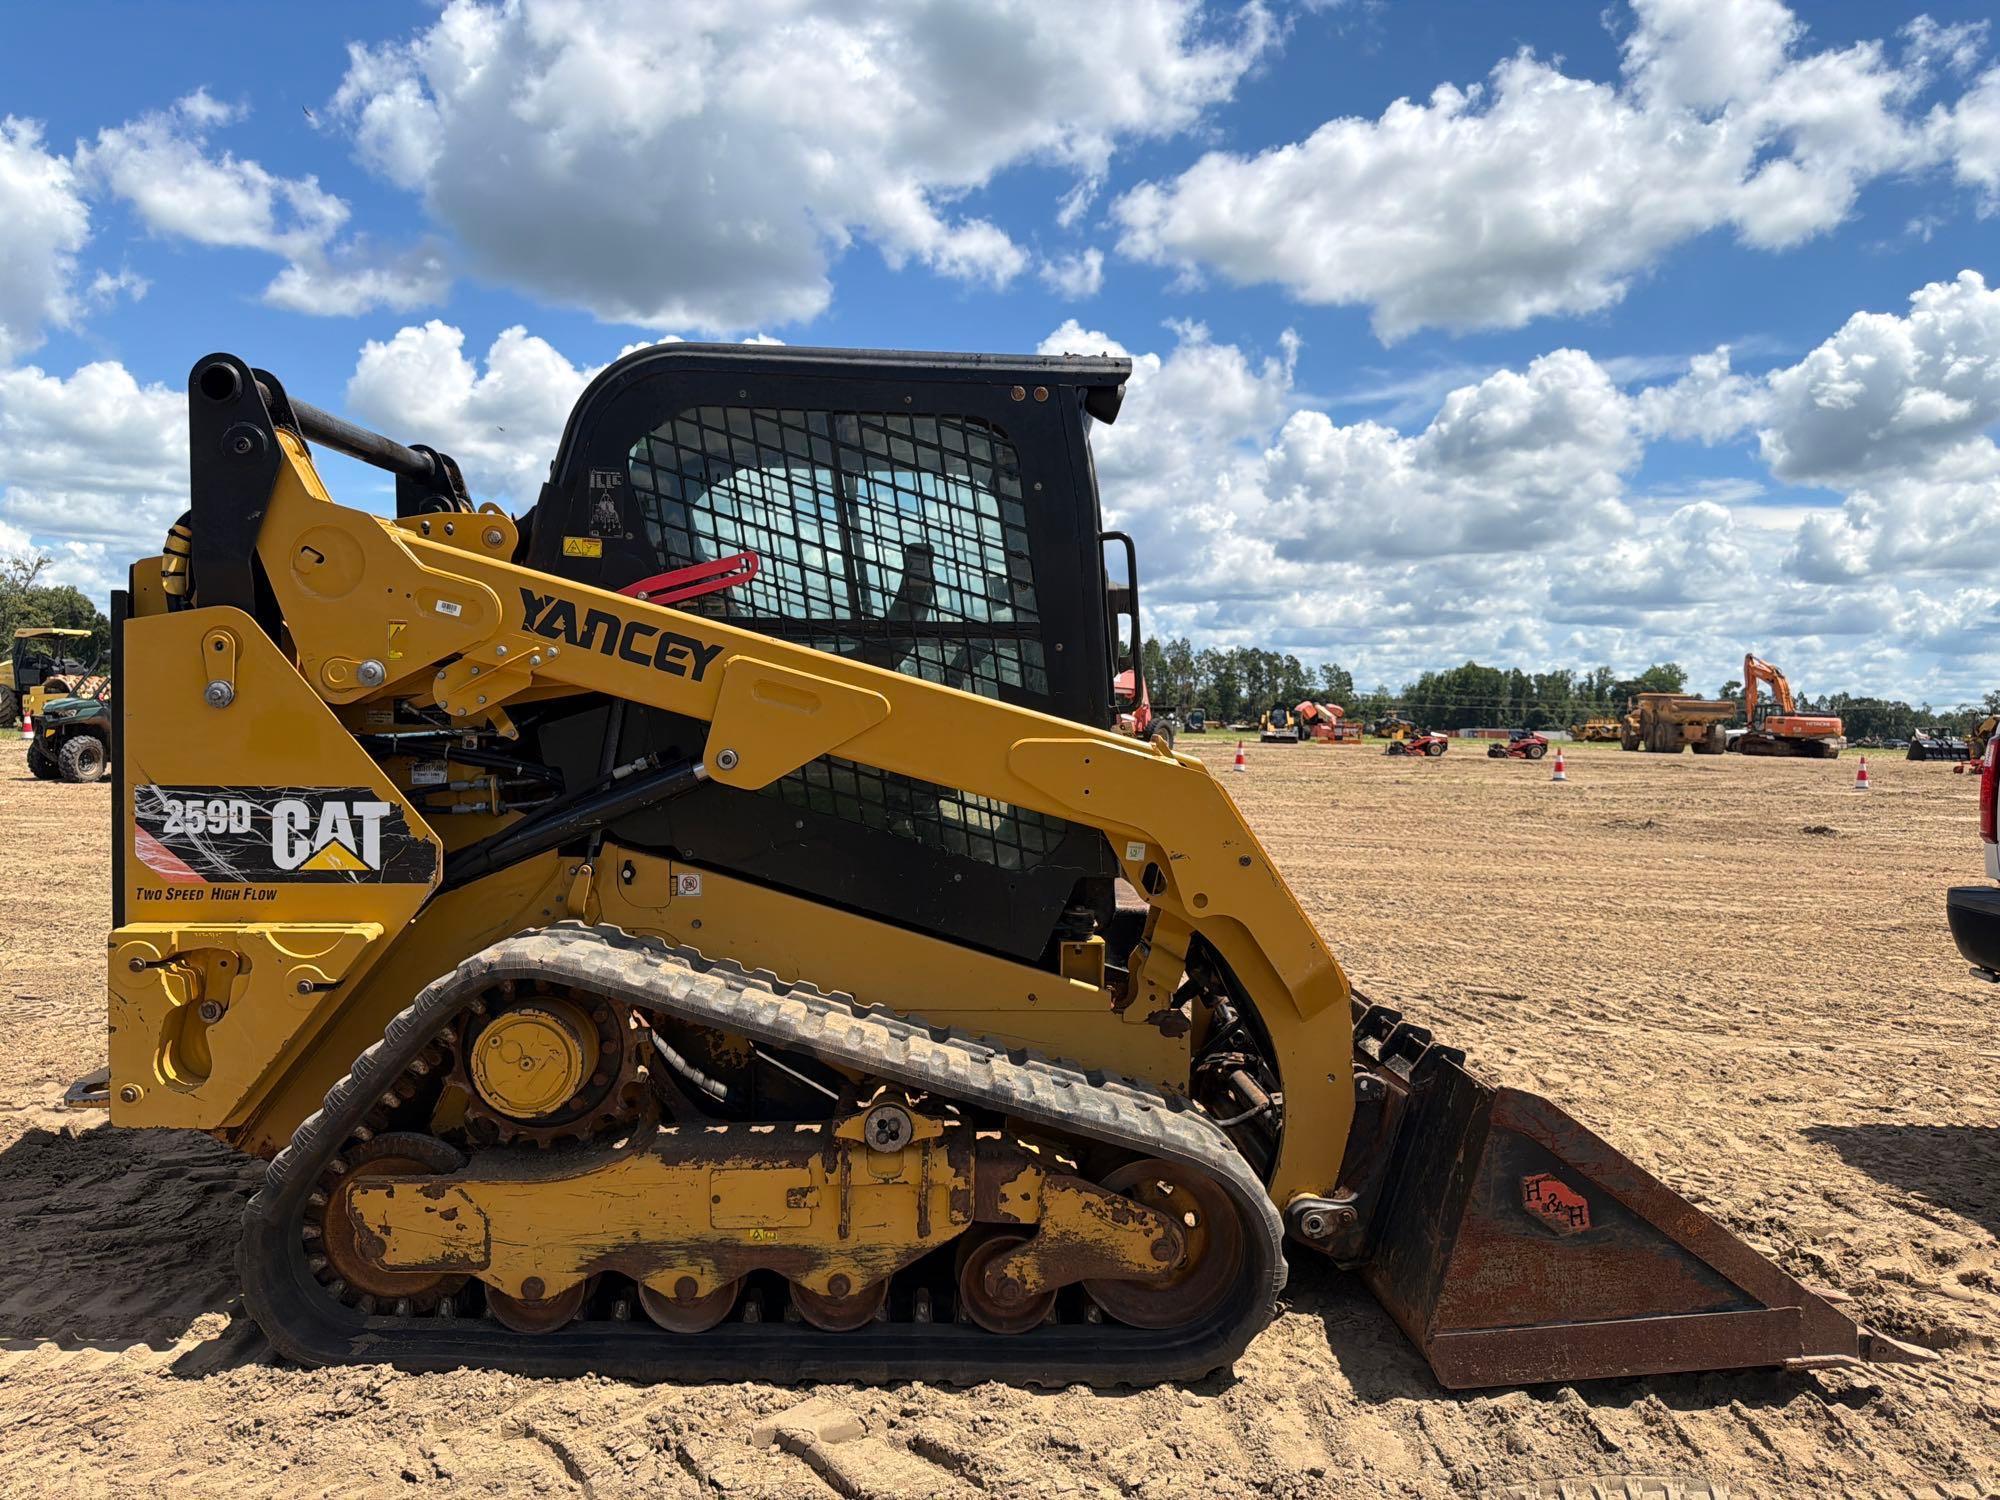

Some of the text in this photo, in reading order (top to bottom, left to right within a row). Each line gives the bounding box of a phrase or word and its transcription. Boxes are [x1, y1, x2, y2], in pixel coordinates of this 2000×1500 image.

[519, 587, 725, 682] YANCEY
[162, 799, 251, 834] 259D
[272, 799, 391, 870] CAT
[136, 887, 277, 901] TWO SPEED HIGH FLOW
